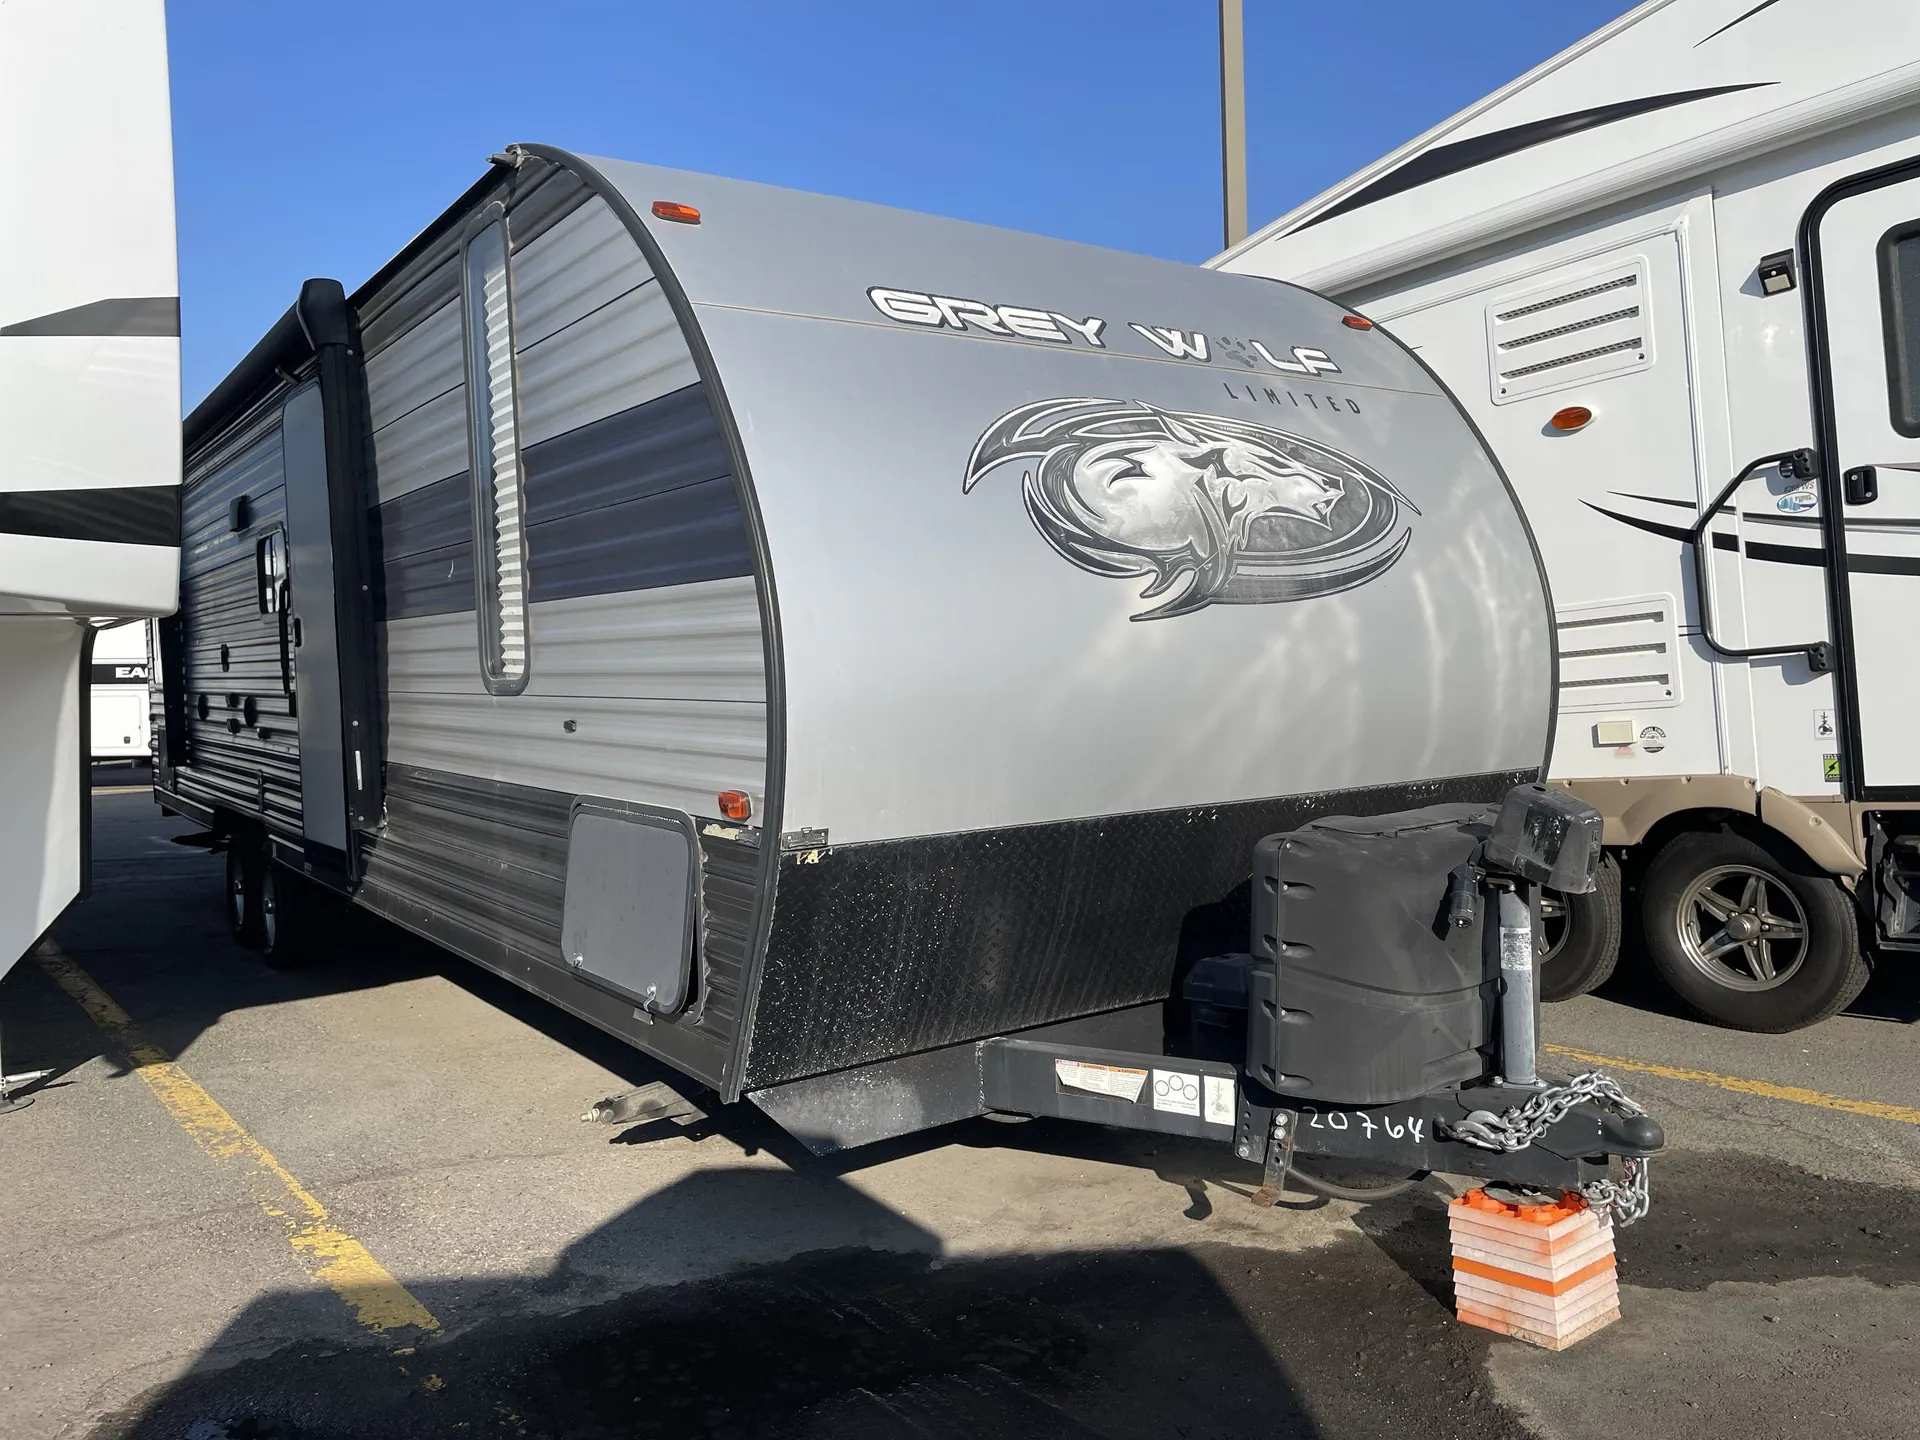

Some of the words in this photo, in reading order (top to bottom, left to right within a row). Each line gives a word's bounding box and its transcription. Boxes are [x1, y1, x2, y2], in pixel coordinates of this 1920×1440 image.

[866, 286, 1107, 348] GREY
[1223, 383, 1360, 414] LIMITED
[1302, 1106, 1425, 1143] 20764
